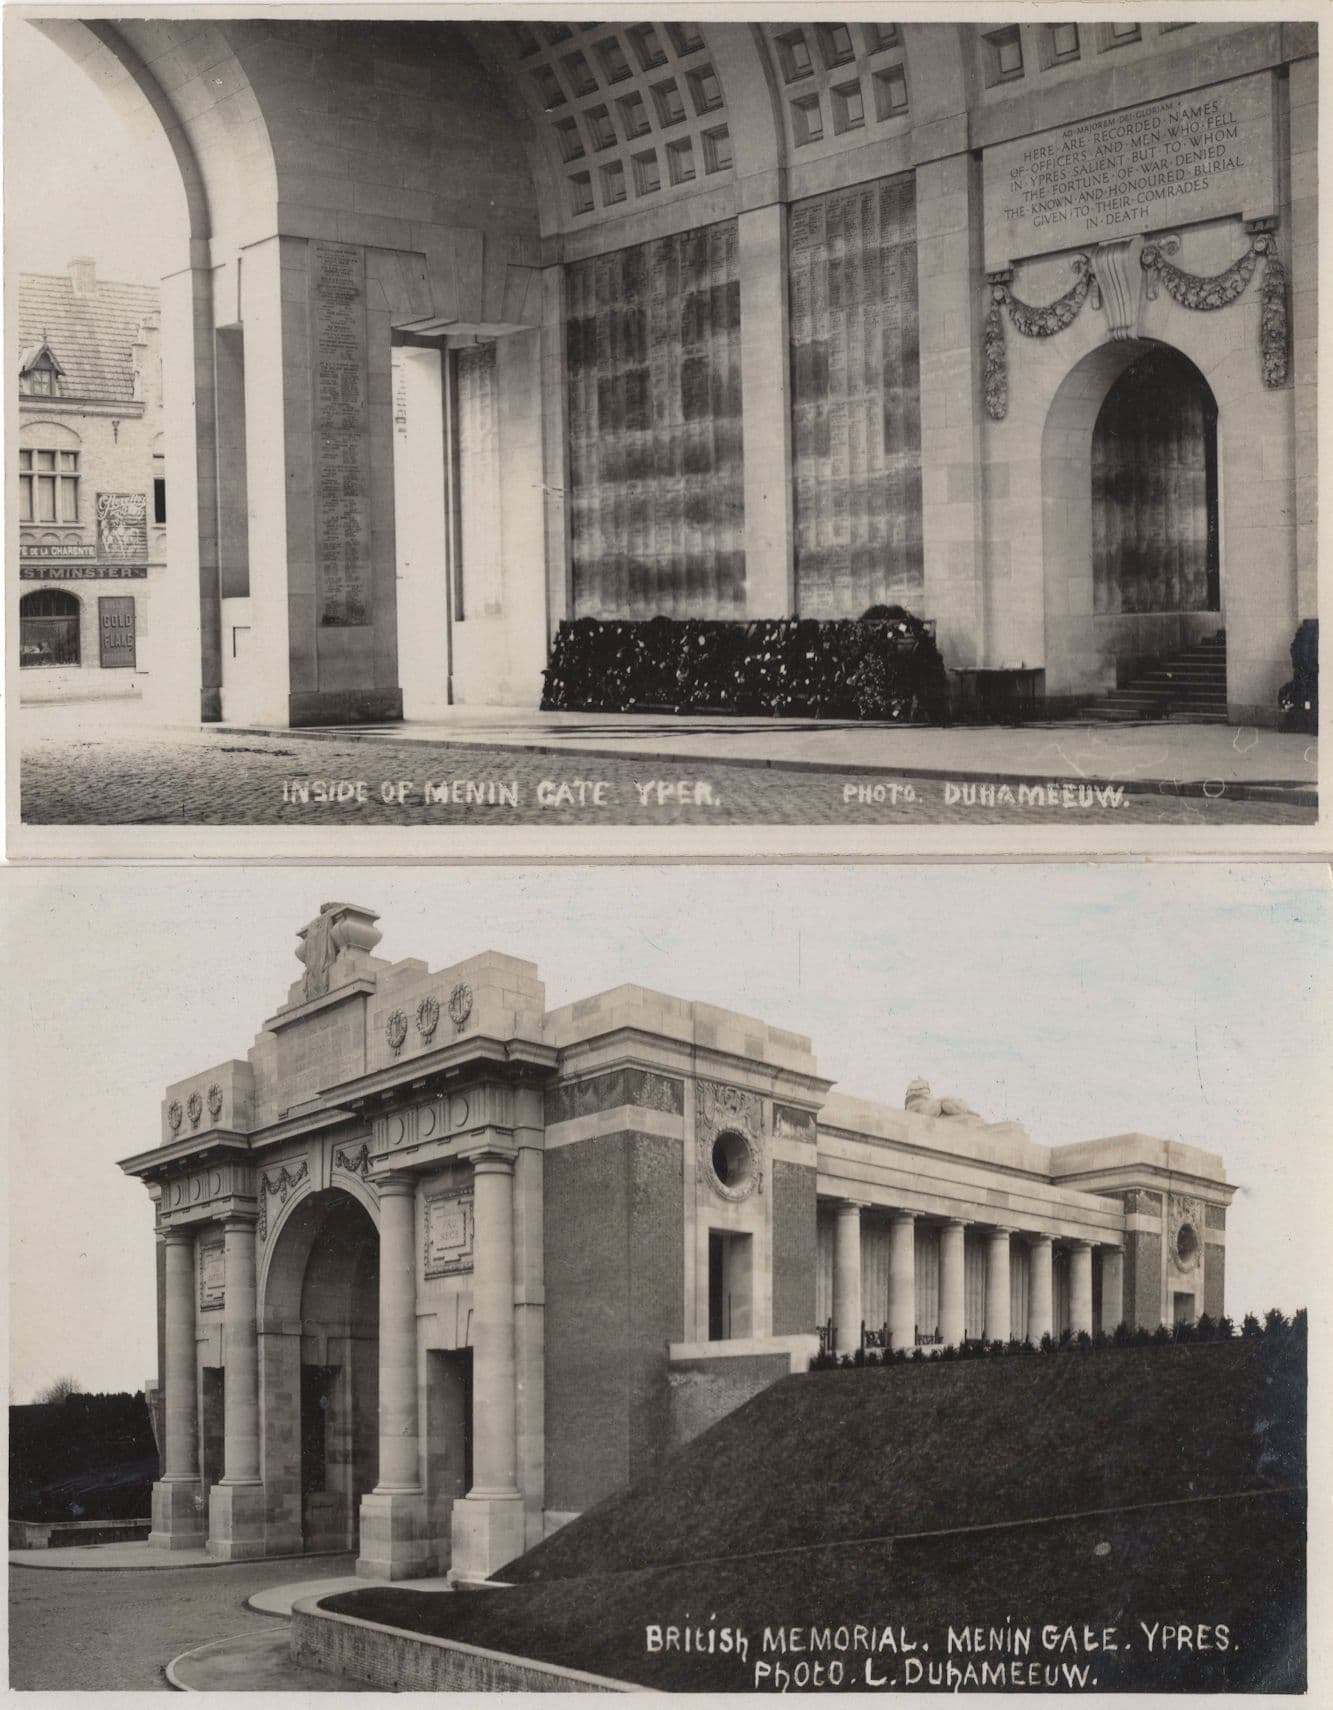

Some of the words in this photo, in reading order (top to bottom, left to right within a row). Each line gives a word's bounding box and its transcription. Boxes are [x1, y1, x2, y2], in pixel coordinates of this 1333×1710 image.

[1011, 167, 1025, 178] OF
[1031, 150, 1087, 173] OFFICERS
[1095, 141, 1123, 157] AND
[1131, 130, 1160, 148] MEN
[1168, 121, 1199, 137] WHO
[1207, 112, 1237, 128] FELL
[1011, 180, 1022, 192] IN
[1030, 169, 1066, 186] YPRES
[1073, 155, 1125, 177] SALIENT
[1132, 147, 1156, 163] BUT
[1164, 141, 1181, 154] TO
[1190, 127, 1238, 147] WHOM
[1024, 145, 1054, 161] HERE
[1062, 137, 1085, 152] ARE
[1094, 117, 1160, 144] RECORDED
[1170, 101, 1218, 124] NAMES
[1004, 206, 1025, 219] THE
[1031, 195, 1073, 214] KNOWN
[1079, 188, 1103, 203] AND
[1109, 168, 1185, 197] HONOURED
[1194, 156, 1244, 176] BURIAL
[1022, 187, 1046, 202] THE
[1052, 172, 1110, 195] FORTUNE
[1118, 167, 1133, 179] OF
[1141, 159, 1168, 173] WAR
[1176, 145, 1225, 166] DENIED
[1033, 211, 1067, 227] GIVEN
[1074, 205, 1089, 217] TO
[1096, 196, 1130, 213] THEIR
[1137, 178, 1209, 203] COMRADES
[1086, 217, 1098, 229] IN
[1106, 206, 1149, 225] DEATH
[24, 568, 131, 578] STMINSTER
[103, 615, 131, 628] GOLD
